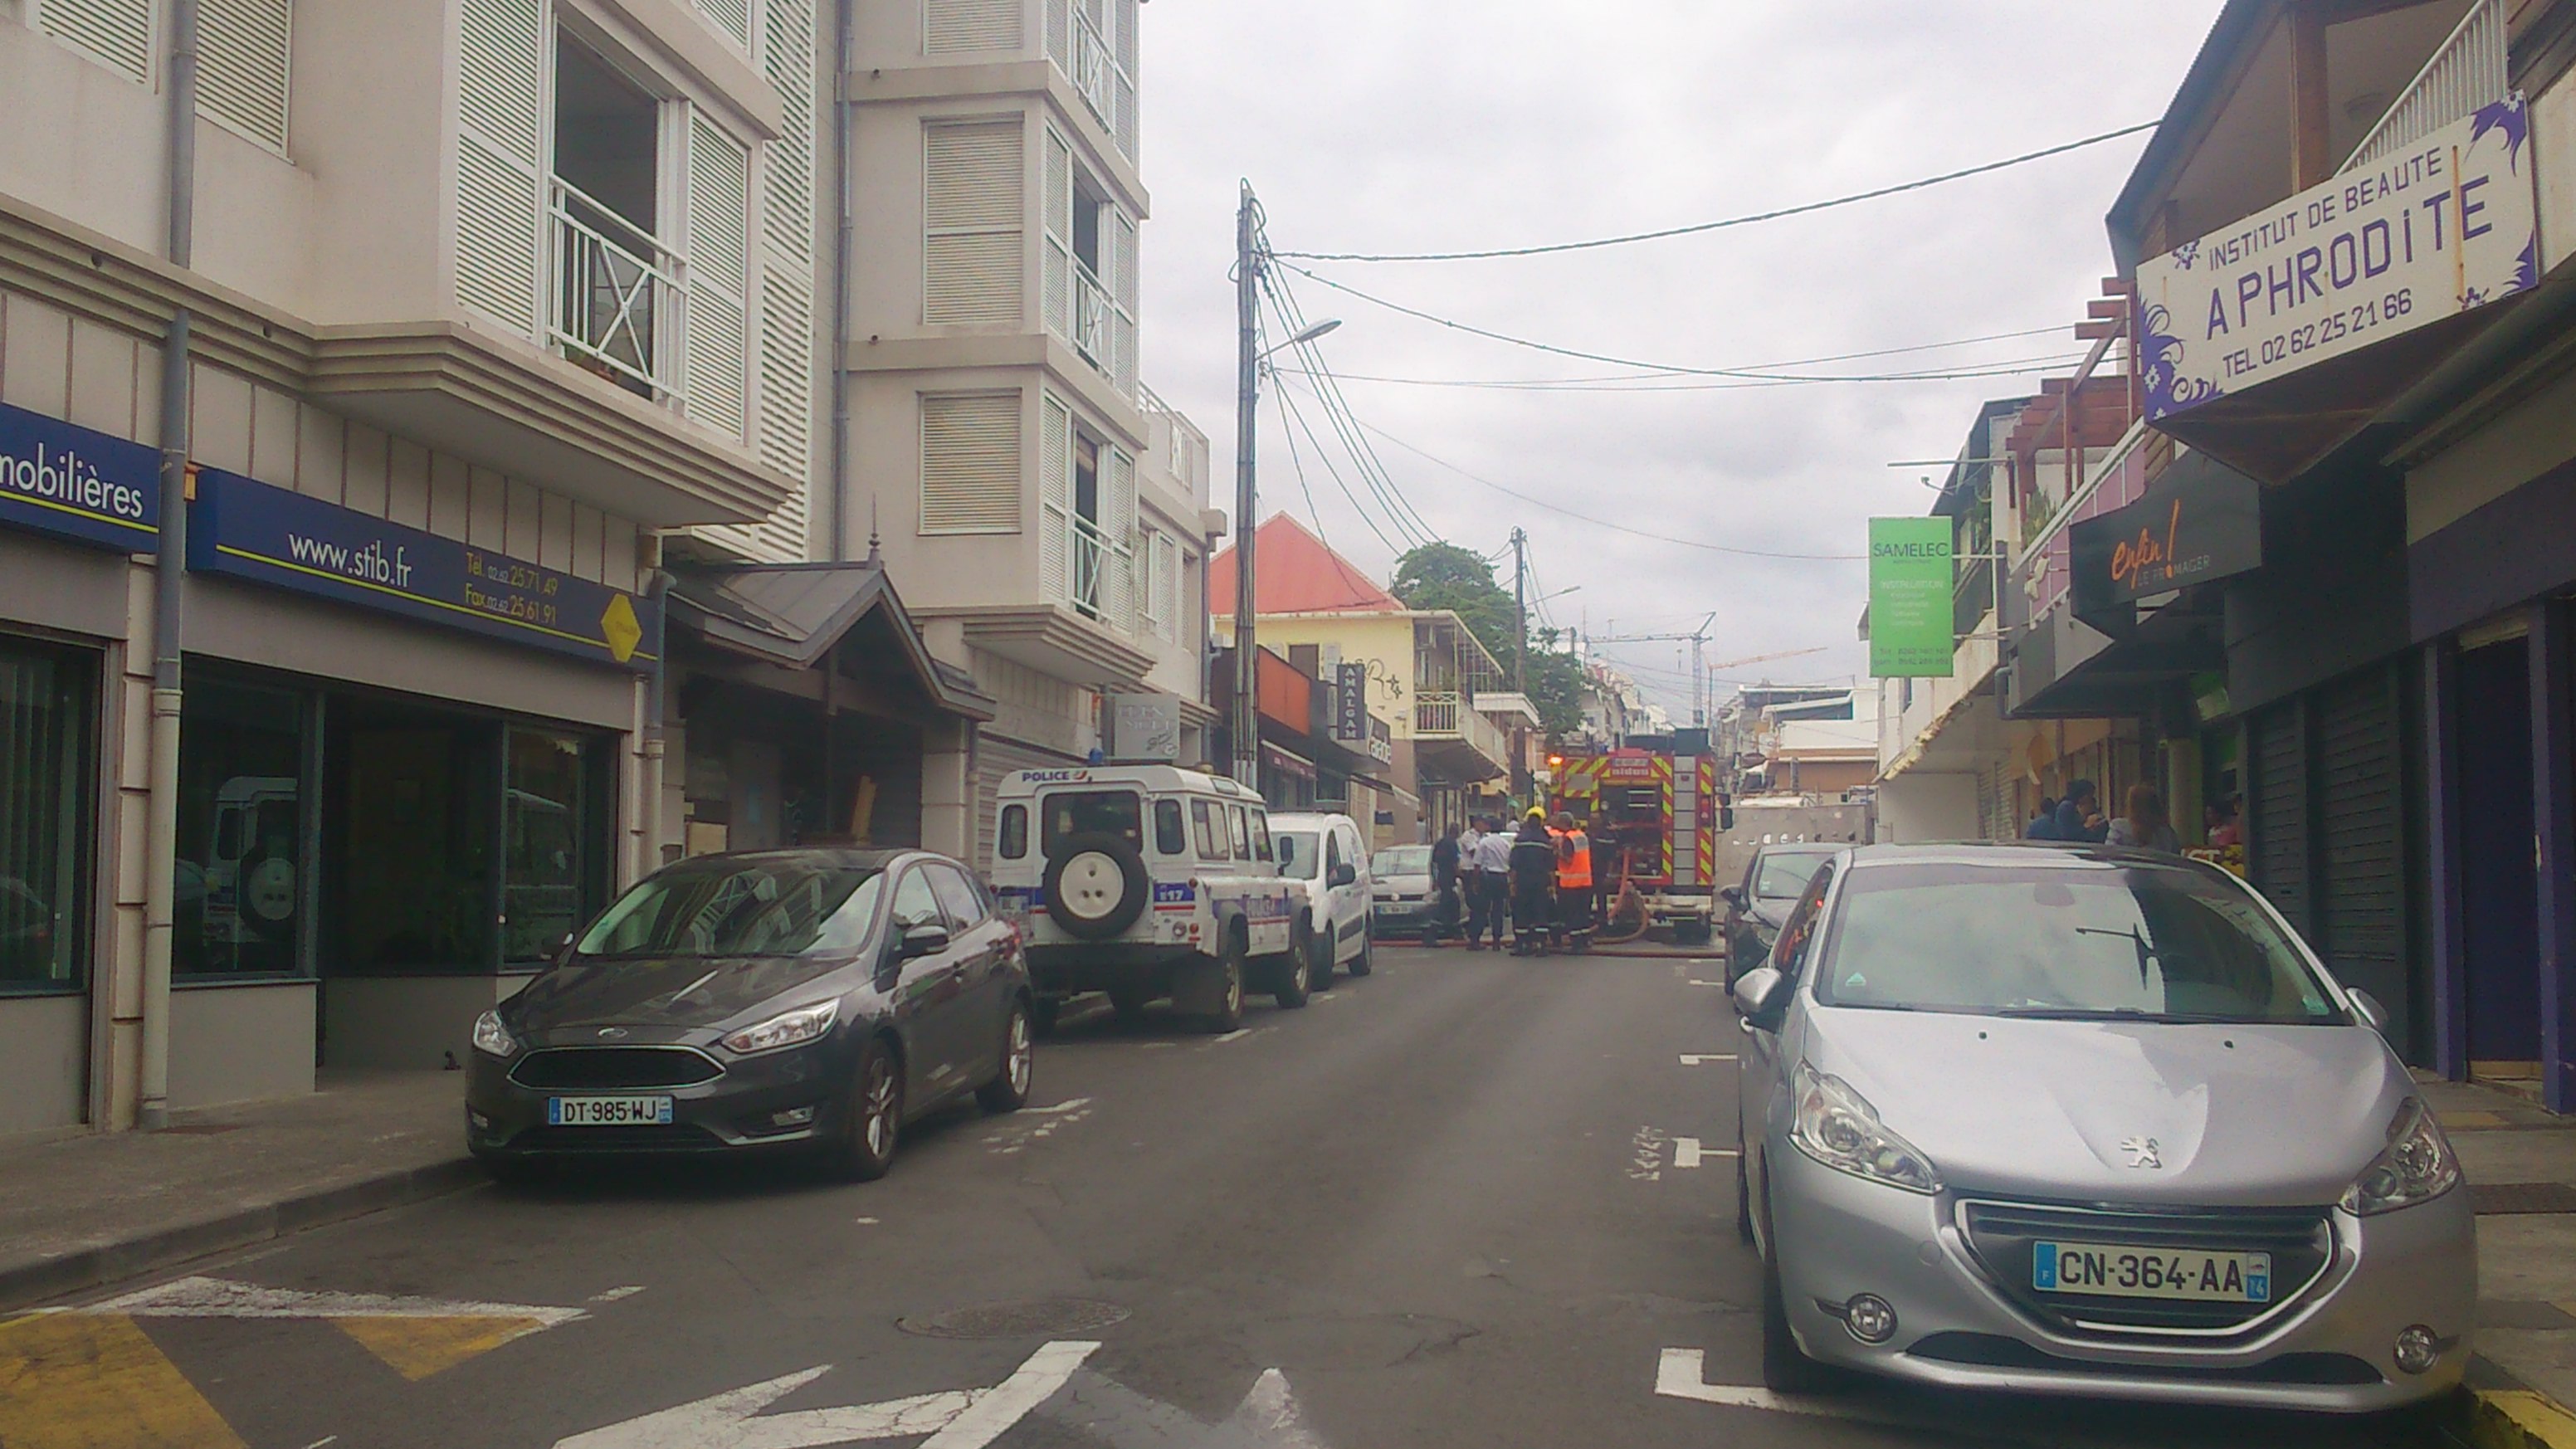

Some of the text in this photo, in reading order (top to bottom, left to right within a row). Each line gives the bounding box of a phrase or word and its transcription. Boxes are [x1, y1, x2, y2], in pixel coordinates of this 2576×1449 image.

[2308, 195, 2336, 229] DE
[2345, 147, 2442, 212] BEAUTE
[2222, 288, 2412, 378] TEL 02 62 25 21 66
[288, 534, 412, 588] www.stib.fr
[1873, 542, 1949, 557] SAMELEC
[1344, 667, 1358, 738] AMALGAM
[1022, 771, 1070, 782] POLICE
[564, 1100, 656, 1122] DT-985-WJ
[2059, 1251, 2244, 1292] CN-364-AA
